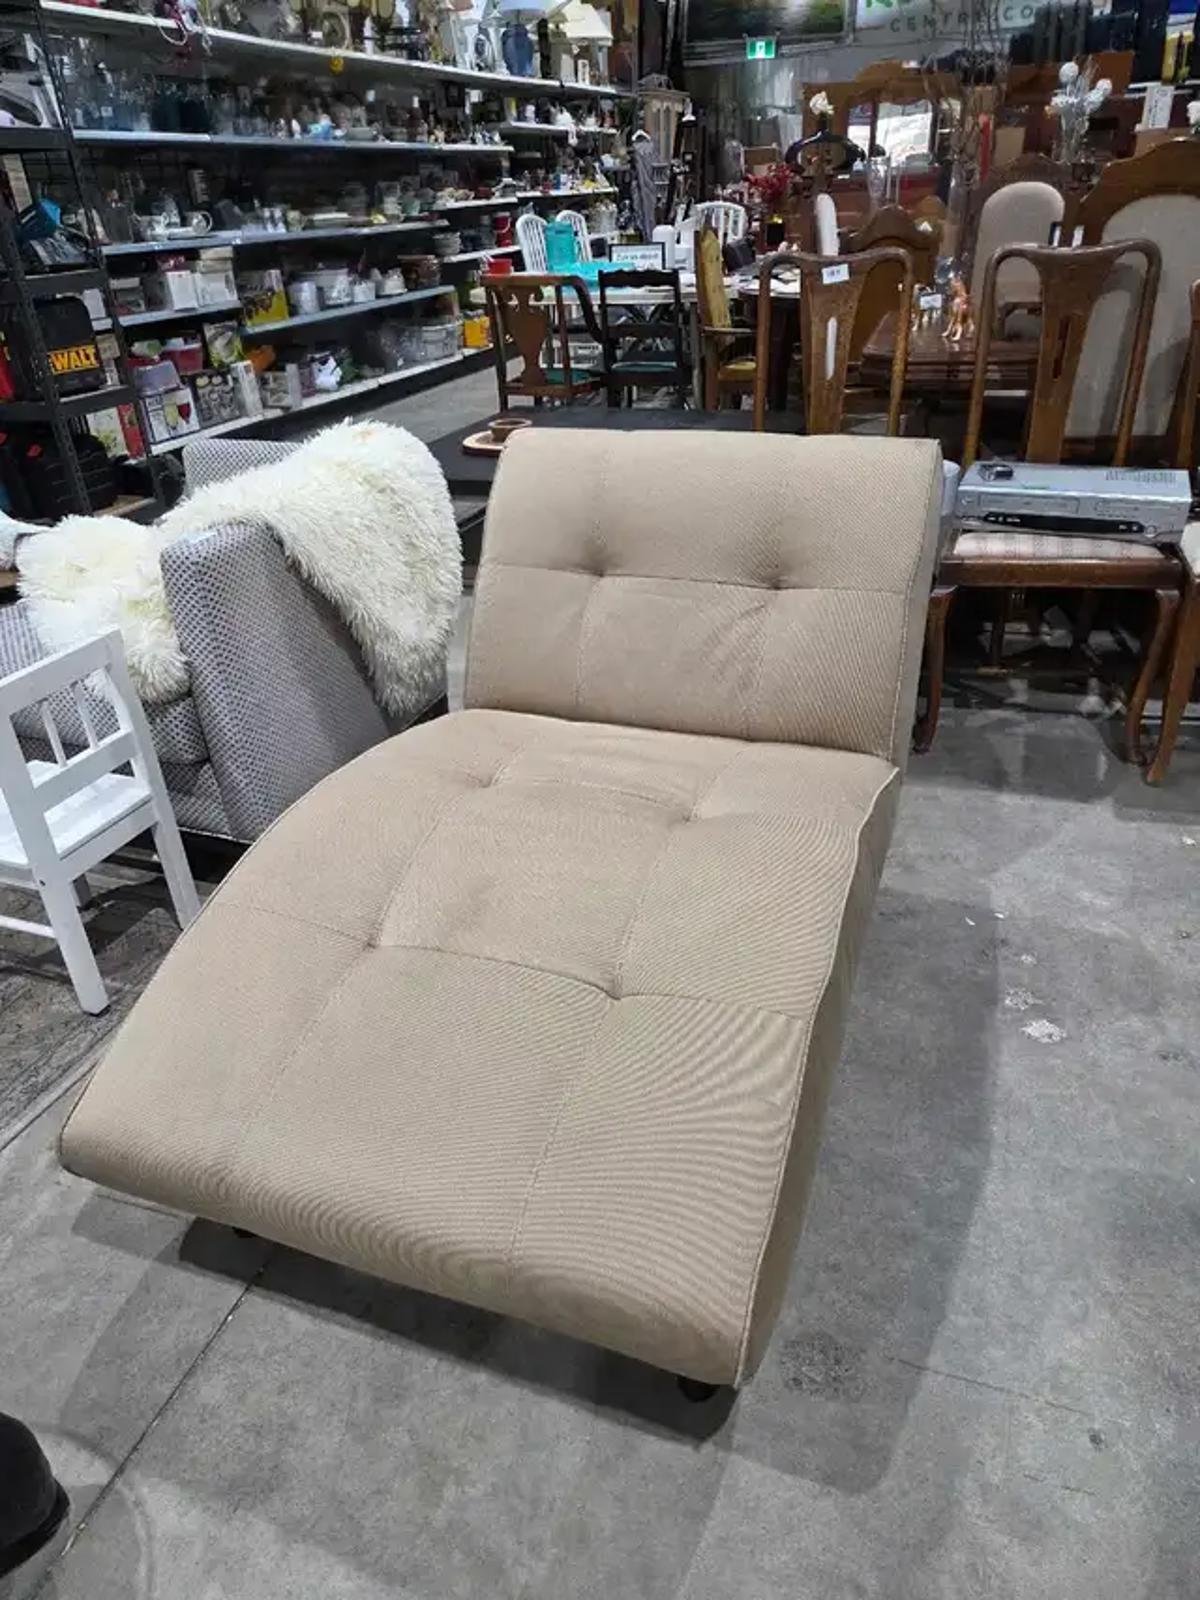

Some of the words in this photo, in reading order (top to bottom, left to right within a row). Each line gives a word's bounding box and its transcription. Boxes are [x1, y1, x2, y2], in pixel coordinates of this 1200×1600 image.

[890, 11, 984, 33] CENTR
[1003, 5, 1034, 22] CO
[50, 345, 98, 372] WALT
